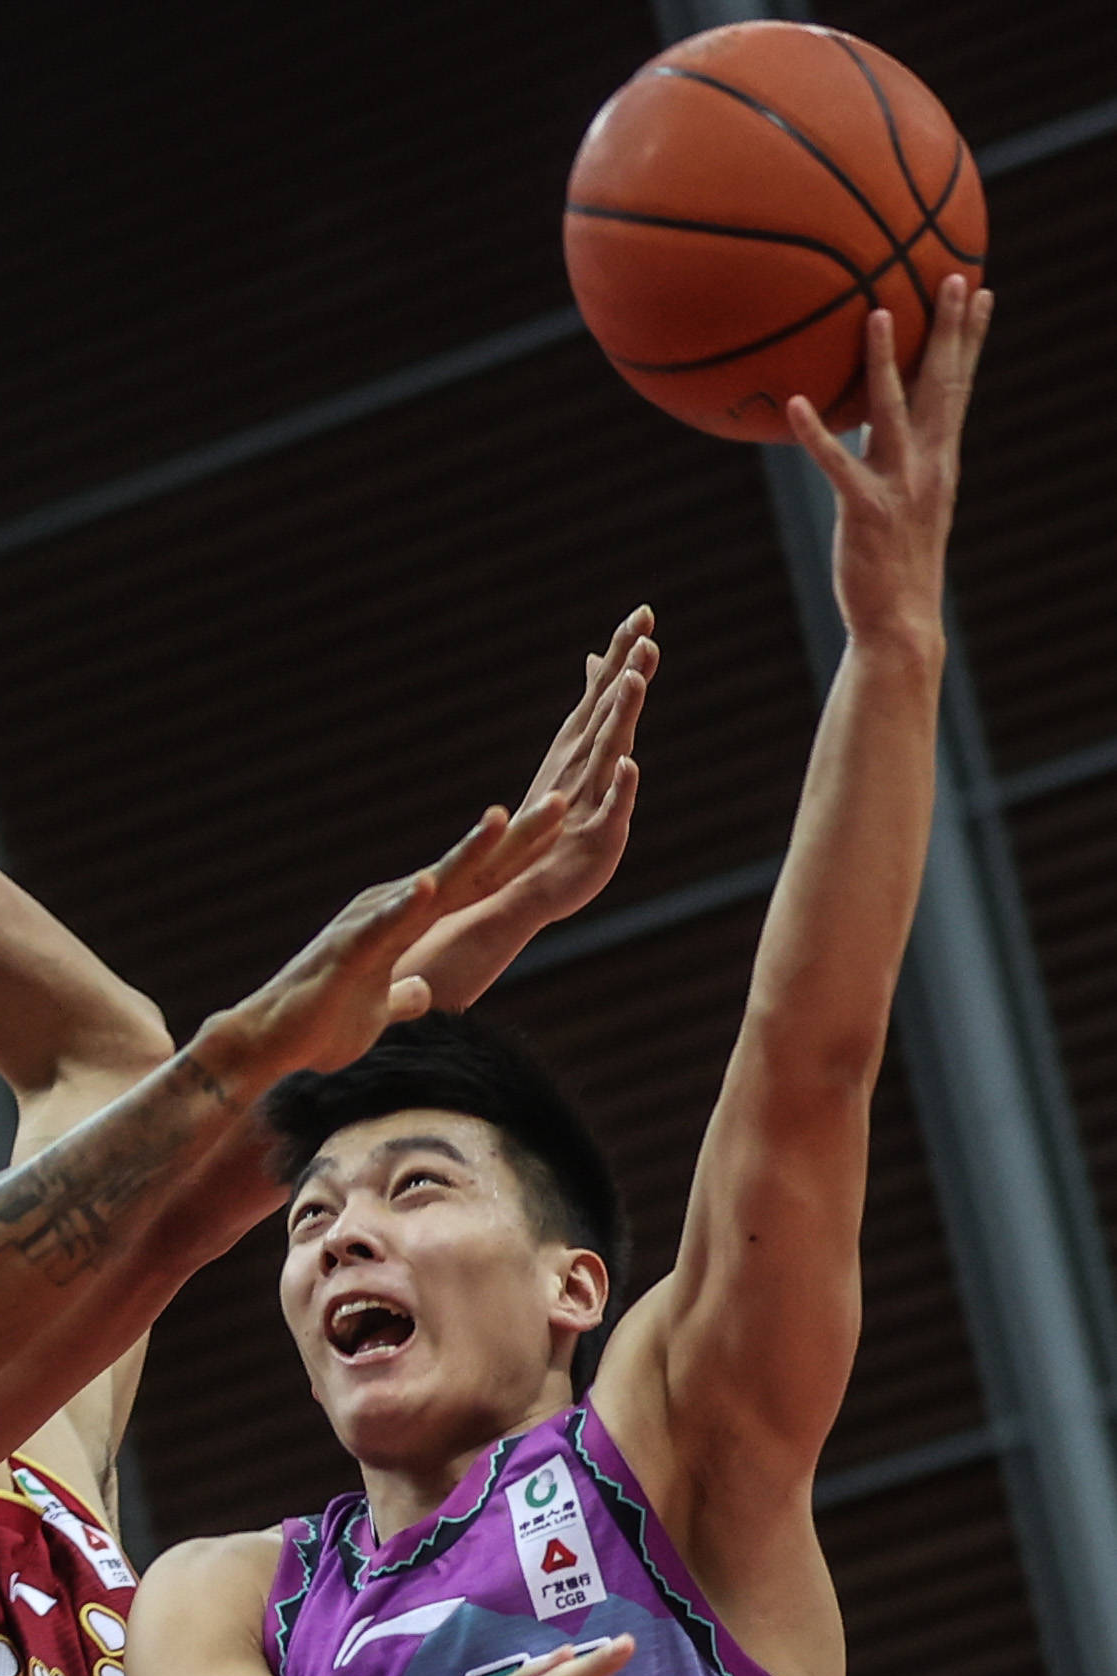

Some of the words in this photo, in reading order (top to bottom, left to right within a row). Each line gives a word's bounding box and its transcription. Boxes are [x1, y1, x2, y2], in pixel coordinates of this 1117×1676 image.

[554, 1511, 578, 1526] LIFE
[541, 1573, 591, 1599] 广发银行
[555, 1593, 587, 1610] CGB
